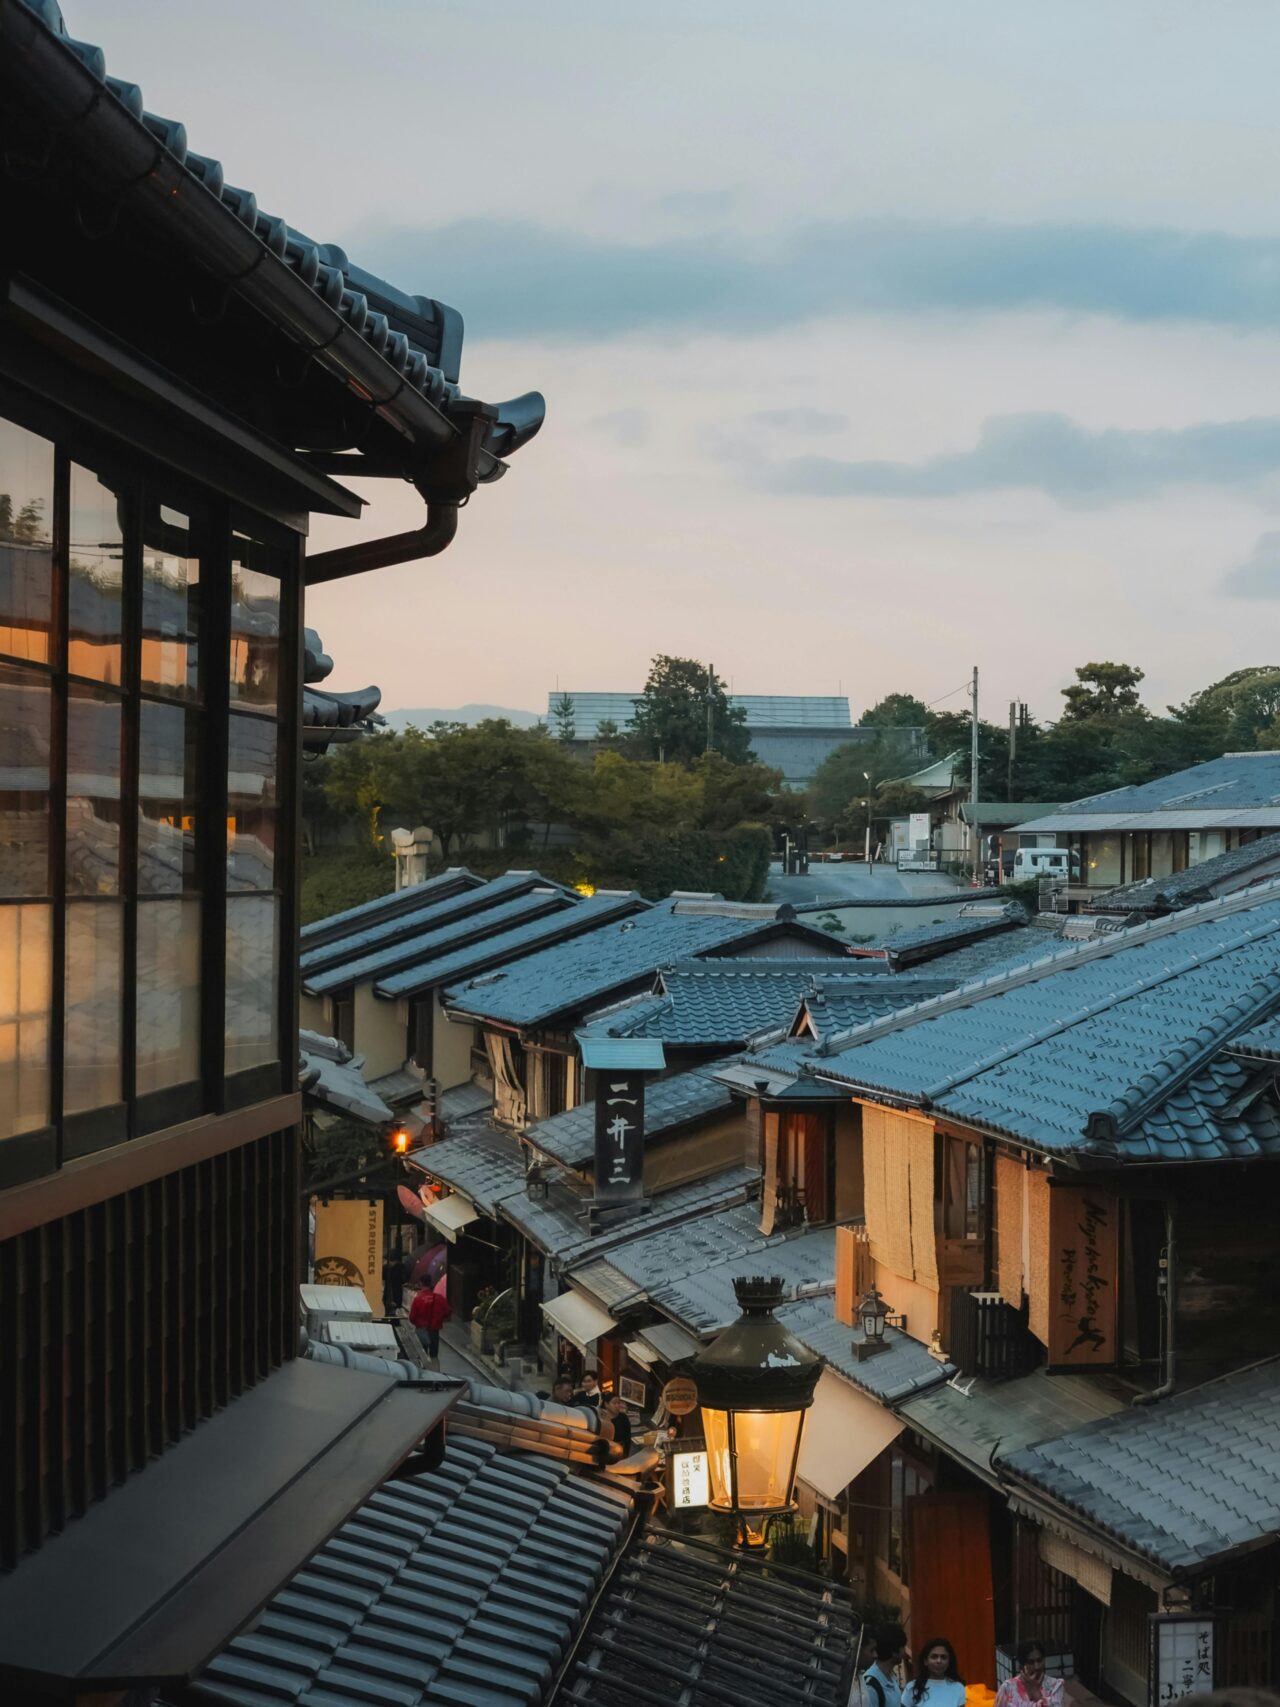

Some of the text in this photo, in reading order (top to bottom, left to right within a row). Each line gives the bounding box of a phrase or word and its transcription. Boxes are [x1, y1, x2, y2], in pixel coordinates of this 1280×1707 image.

[606, 1082, 638, 1184] 二井三
[367, 1210, 377, 1275] STARBUCKS
[1197, 1631, 1211, 1676] そば処
